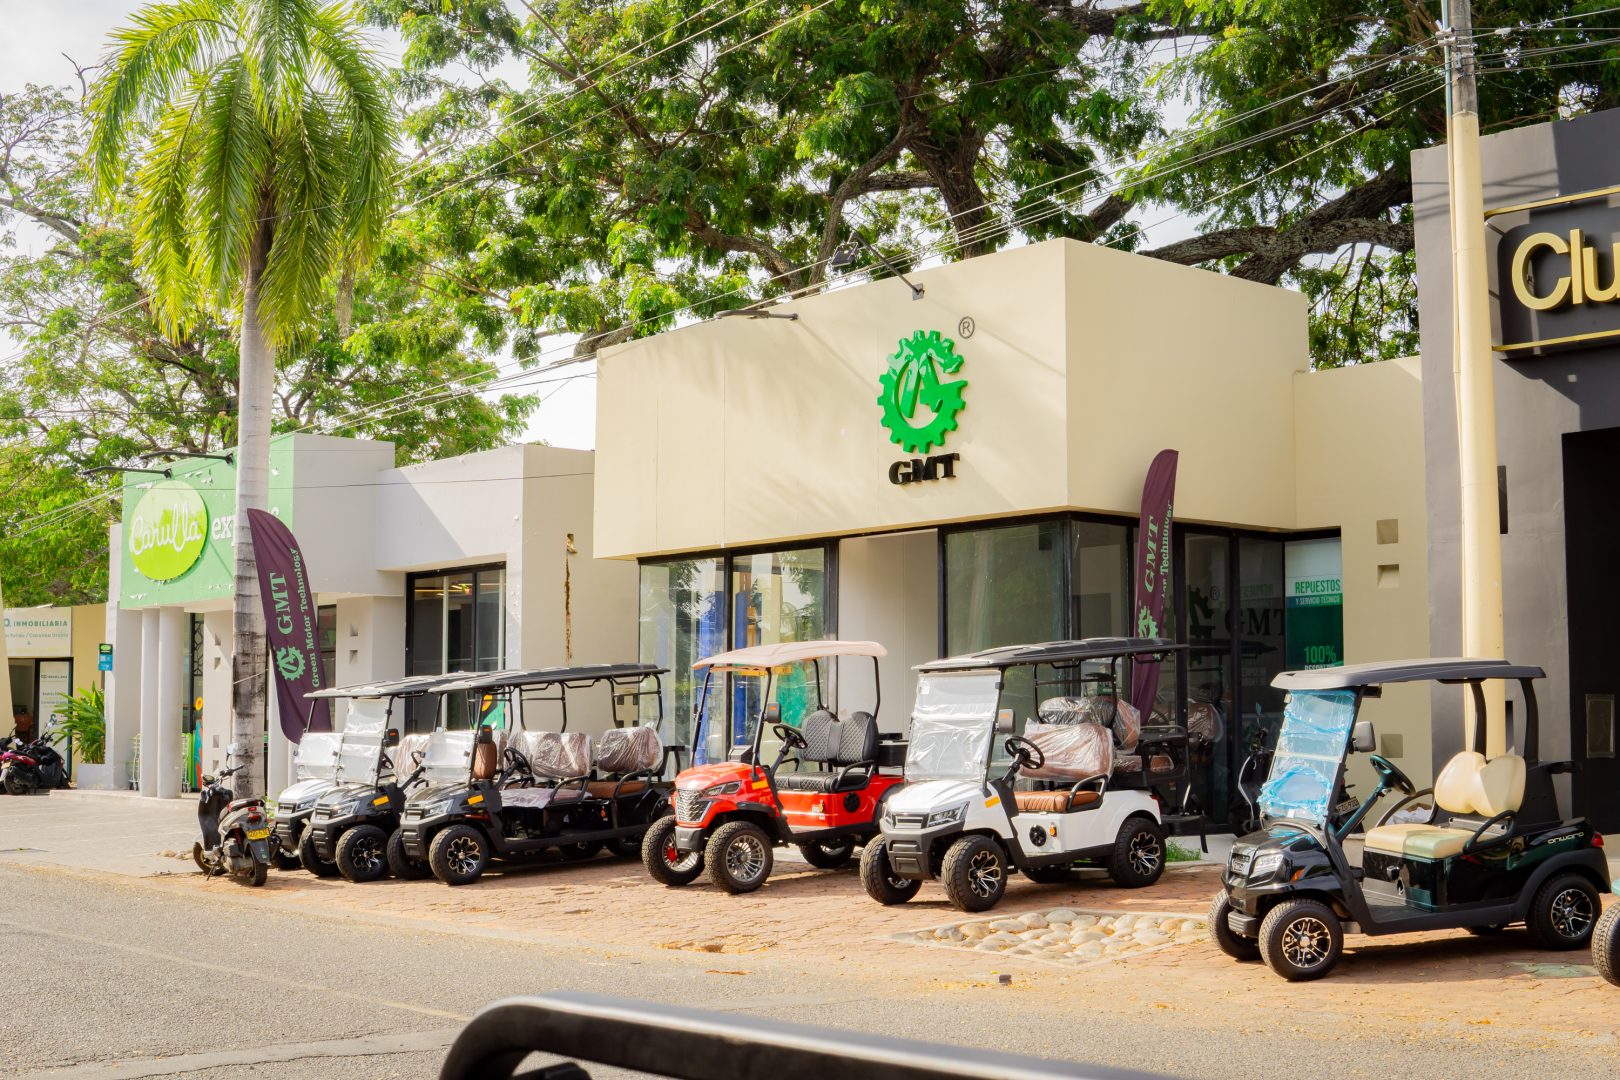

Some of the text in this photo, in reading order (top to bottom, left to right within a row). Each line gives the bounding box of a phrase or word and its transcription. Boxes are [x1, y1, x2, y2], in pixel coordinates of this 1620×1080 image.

[889, 453, 960, 485] GMT
[130, 502, 202, 556] Carulla
[1144, 515, 1159, 592] GMT
[269, 572, 294, 635] GMT
[1295, 579, 1341, 594] REPUESTOS
[290, 547, 320, 688] Green Motor Technology
[1304, 644, 1337, 664] 100%
